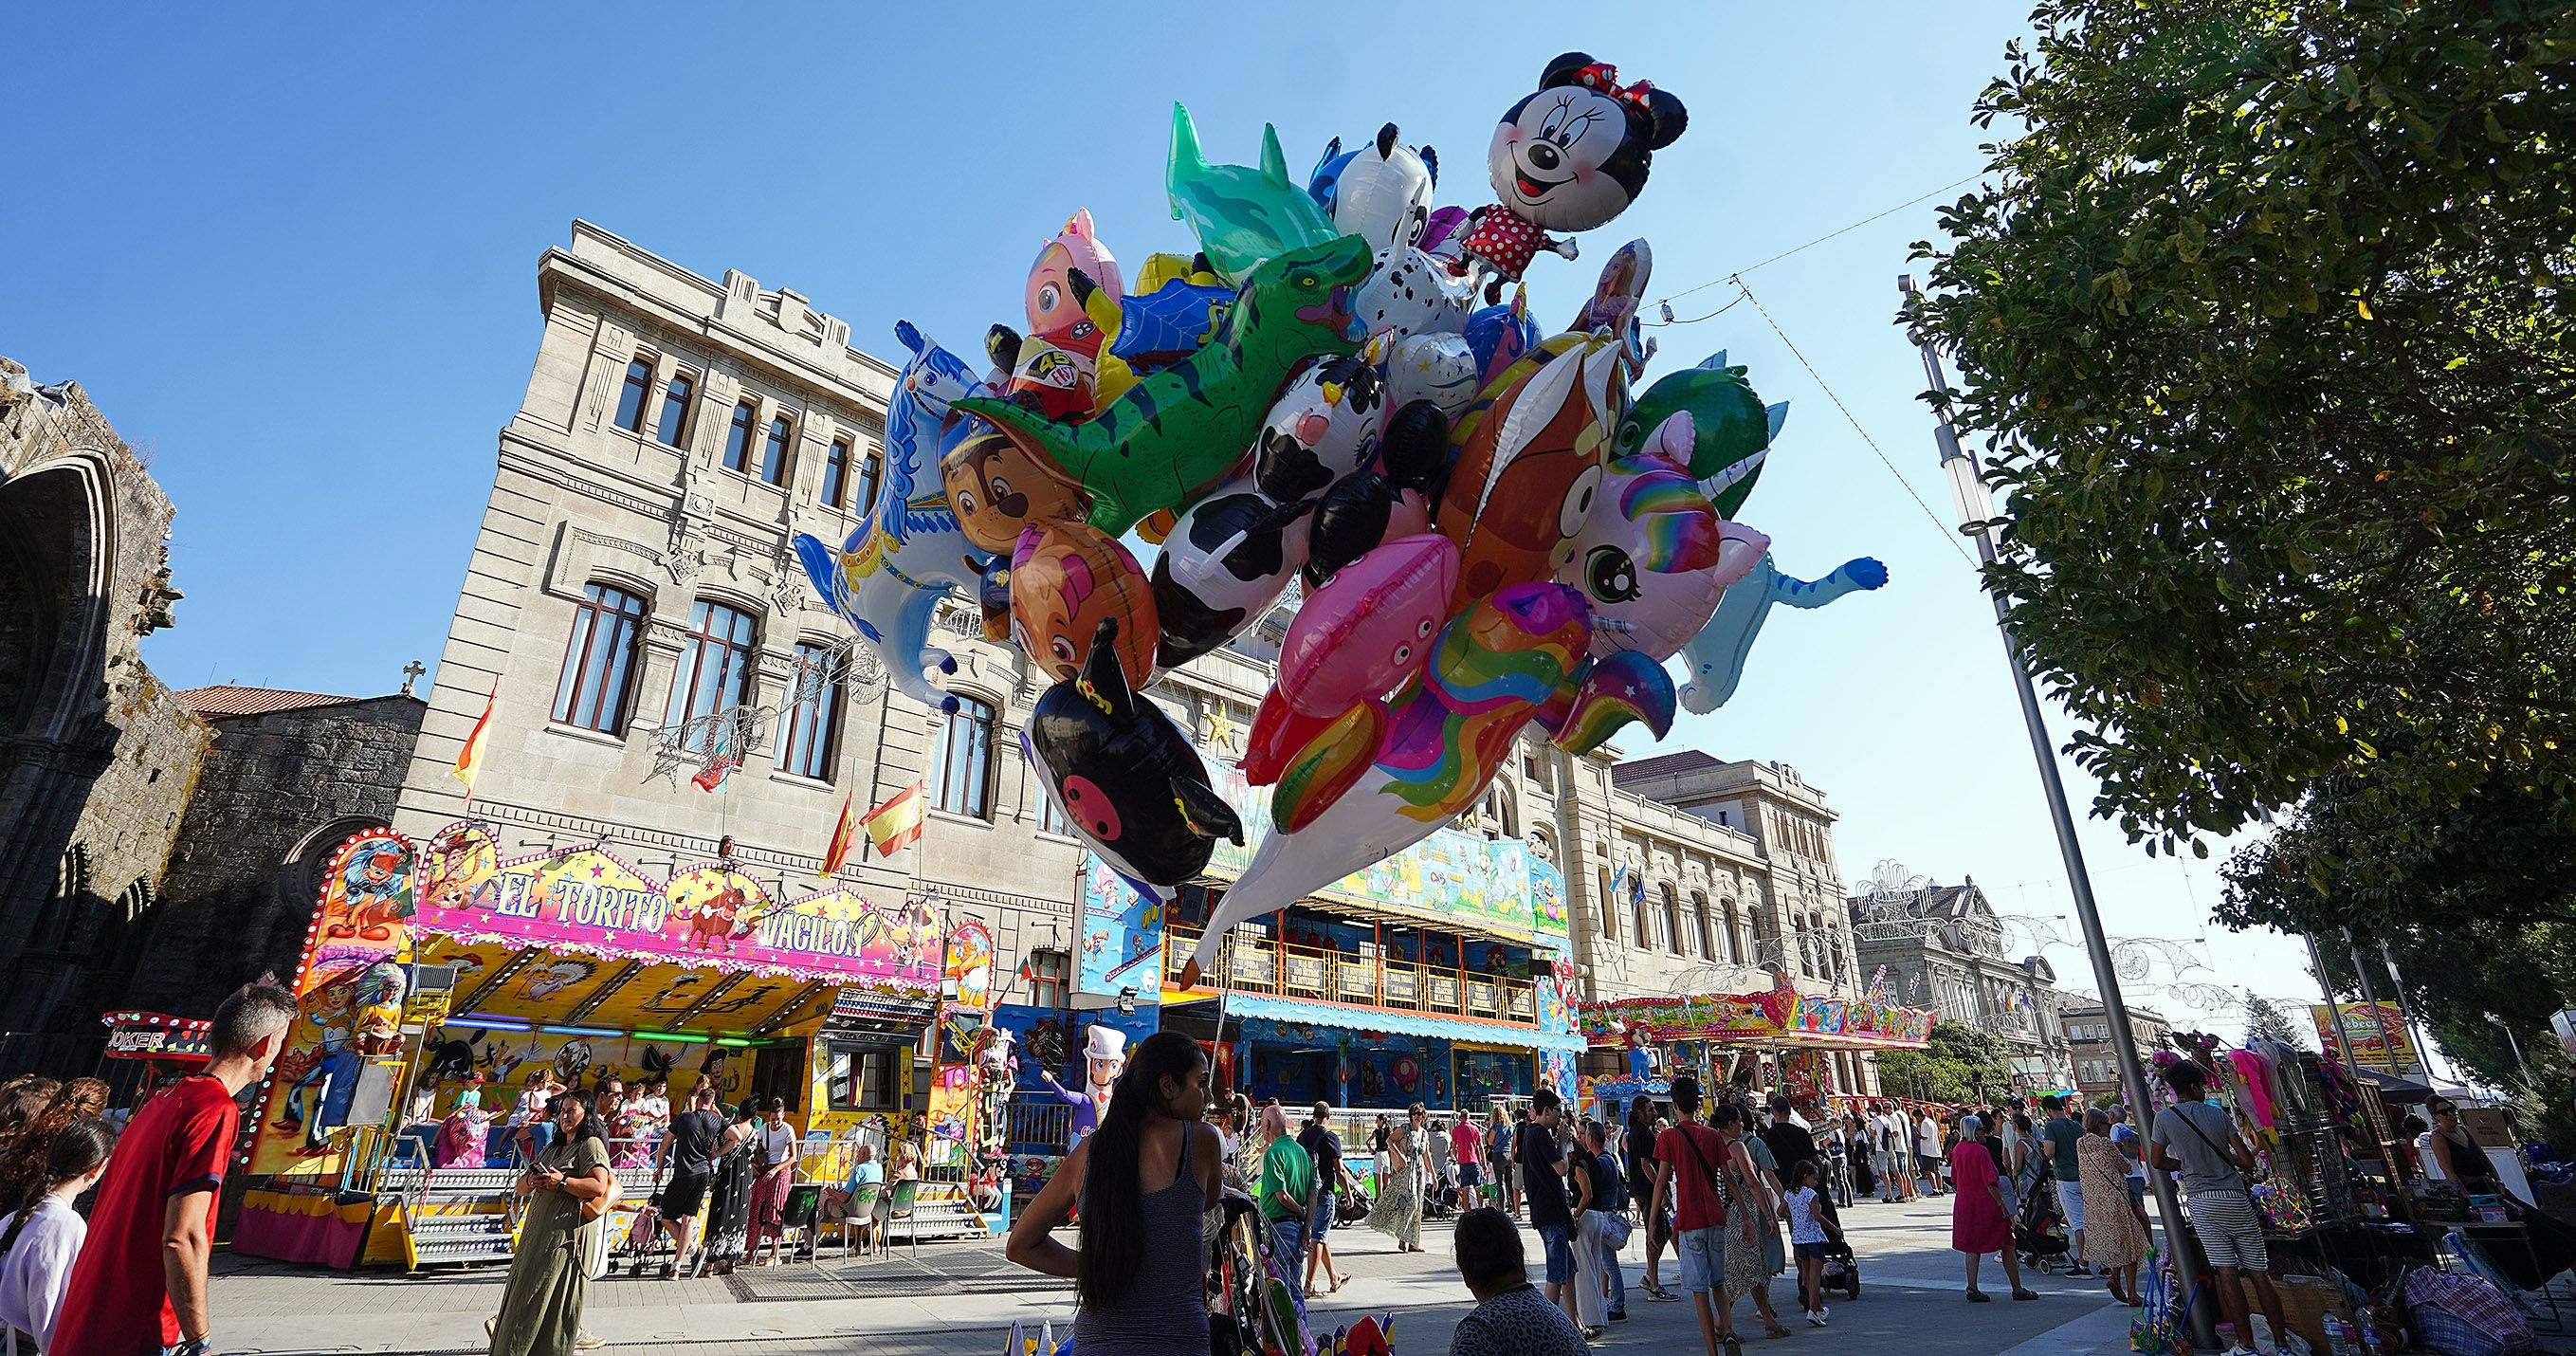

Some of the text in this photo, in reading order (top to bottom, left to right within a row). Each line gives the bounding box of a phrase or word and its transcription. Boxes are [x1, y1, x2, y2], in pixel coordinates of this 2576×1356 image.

[495, 872, 866, 959] EL TORITO VACILON
